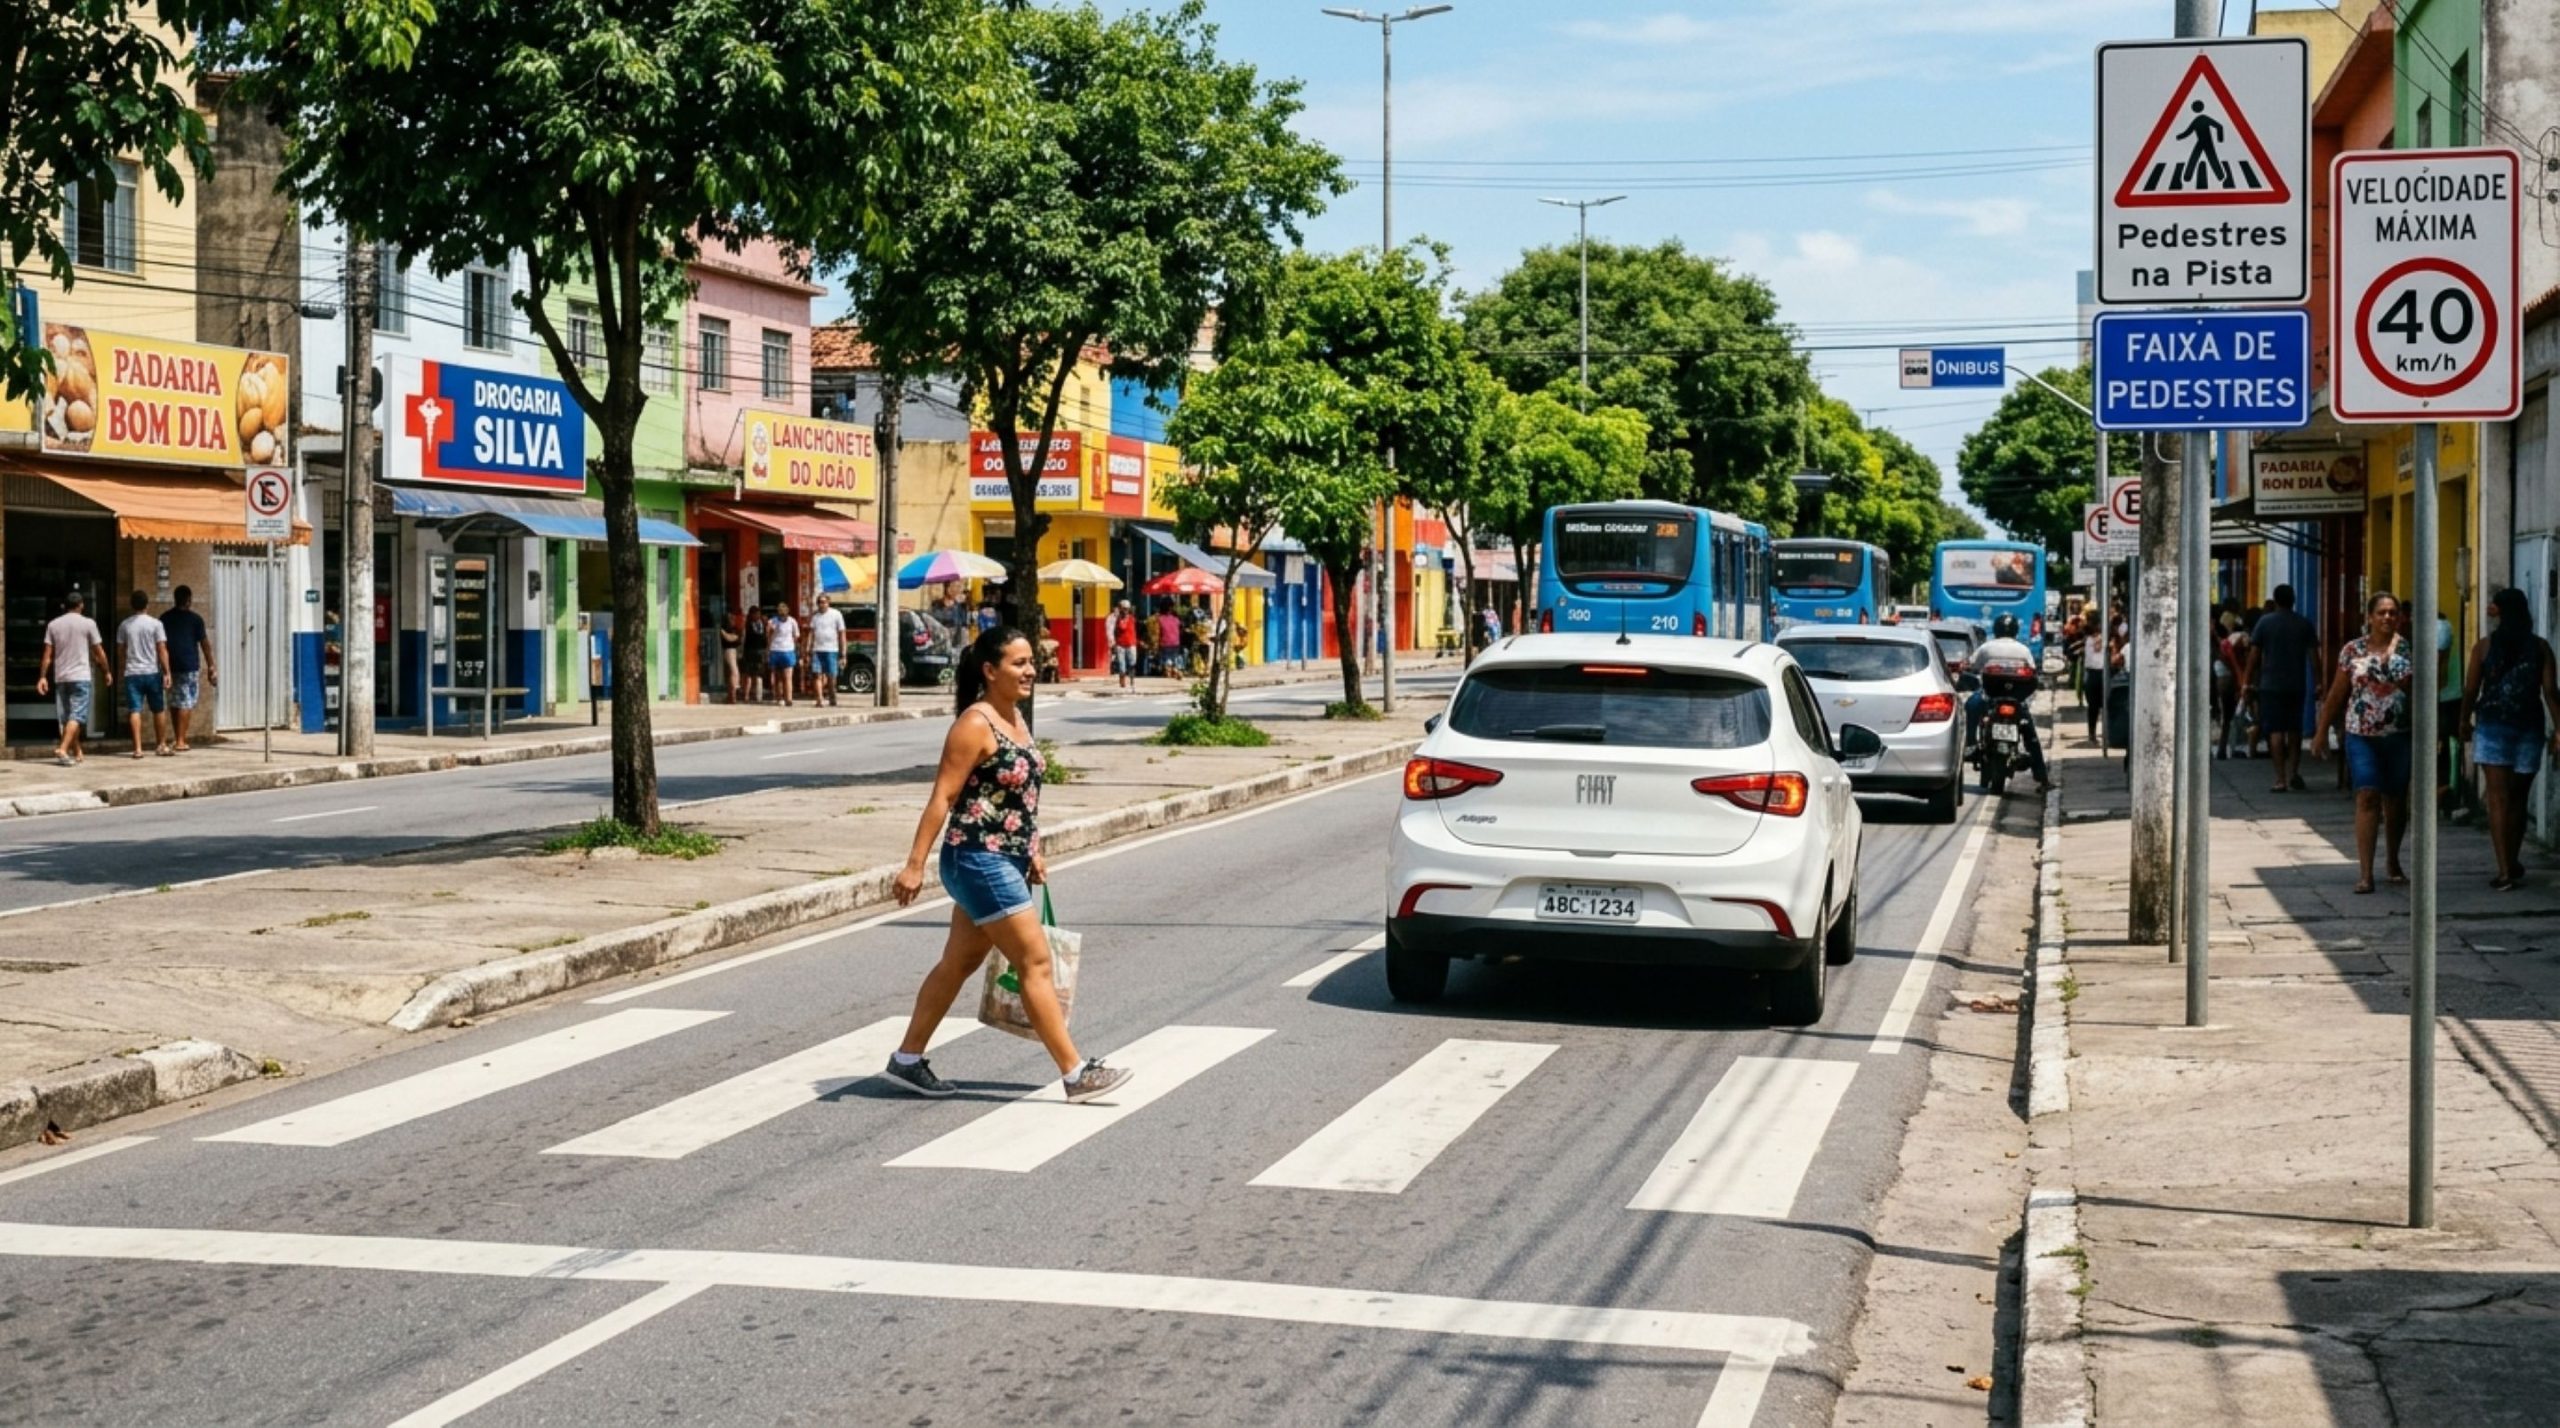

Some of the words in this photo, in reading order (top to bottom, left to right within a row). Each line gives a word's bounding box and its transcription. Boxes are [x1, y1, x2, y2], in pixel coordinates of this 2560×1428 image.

[2346, 173, 2507, 205] VELOCIDADE
[2117, 222, 2287, 250] Pedestres
[2375, 209, 2477, 242] MÁXIMA
[2131, 266, 2170, 287] na
[2186, 260, 2273, 286] Pista
[2376, 287, 2474, 345] 40
[2126, 331, 2222, 363] FAIXA
[2233, 330, 2277, 361] DE
[2396, 352, 2457, 372] km/h
[113, 348, 222, 396] PADARIA
[474, 379, 562, 417] DROGARIA
[2107, 377, 2297, 410] PEDESTRES
[108, 398, 171, 446] BOM
[178, 405, 227, 450] DIA
[473, 415, 564, 470] SILVA
[790, 459, 812, 486] DO
